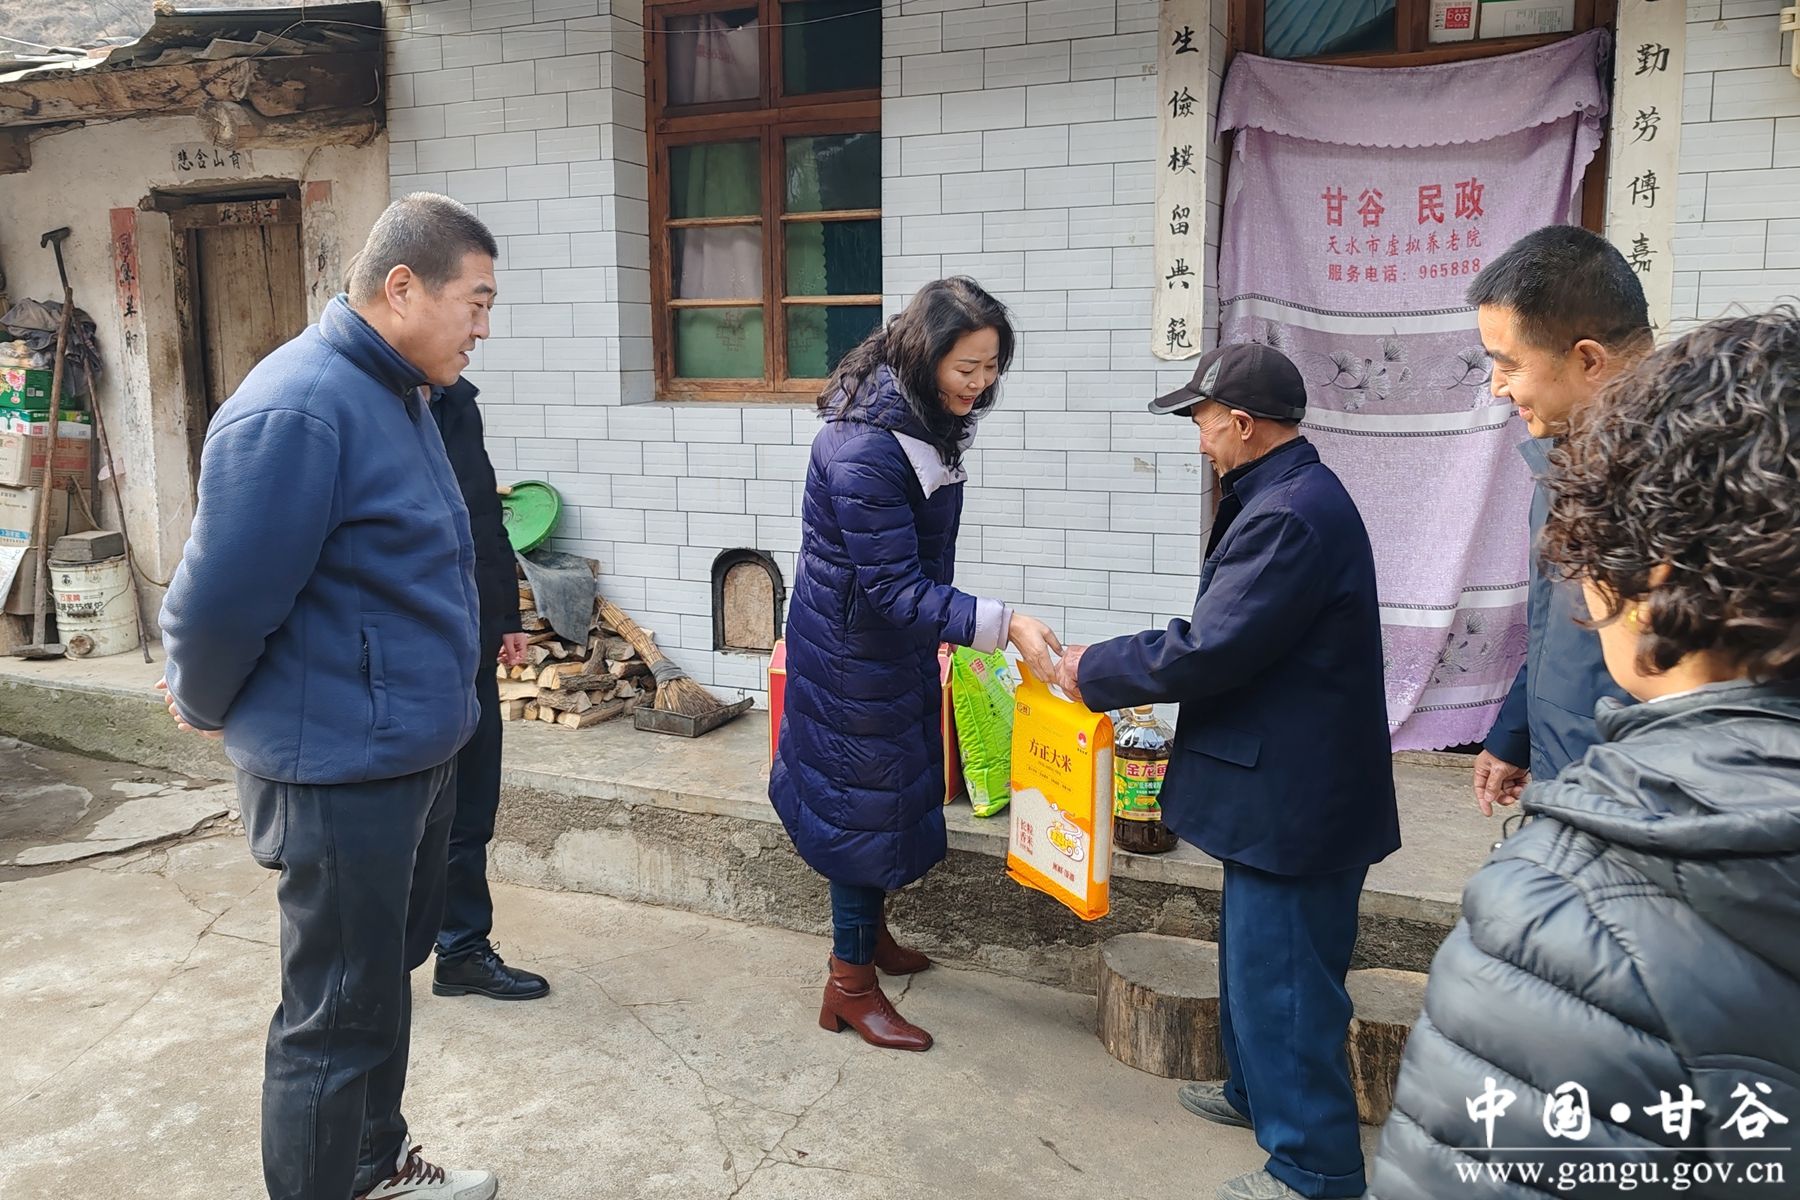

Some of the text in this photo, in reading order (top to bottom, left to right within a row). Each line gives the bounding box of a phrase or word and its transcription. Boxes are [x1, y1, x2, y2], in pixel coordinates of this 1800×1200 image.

[1321, 176, 1486, 228] 甘谷 民政
[1326, 225, 1483, 258] 天水市虚拟养老院
[1418, 257, 1482, 280] 965888
[1029, 738, 1072, 773] 方正大米
